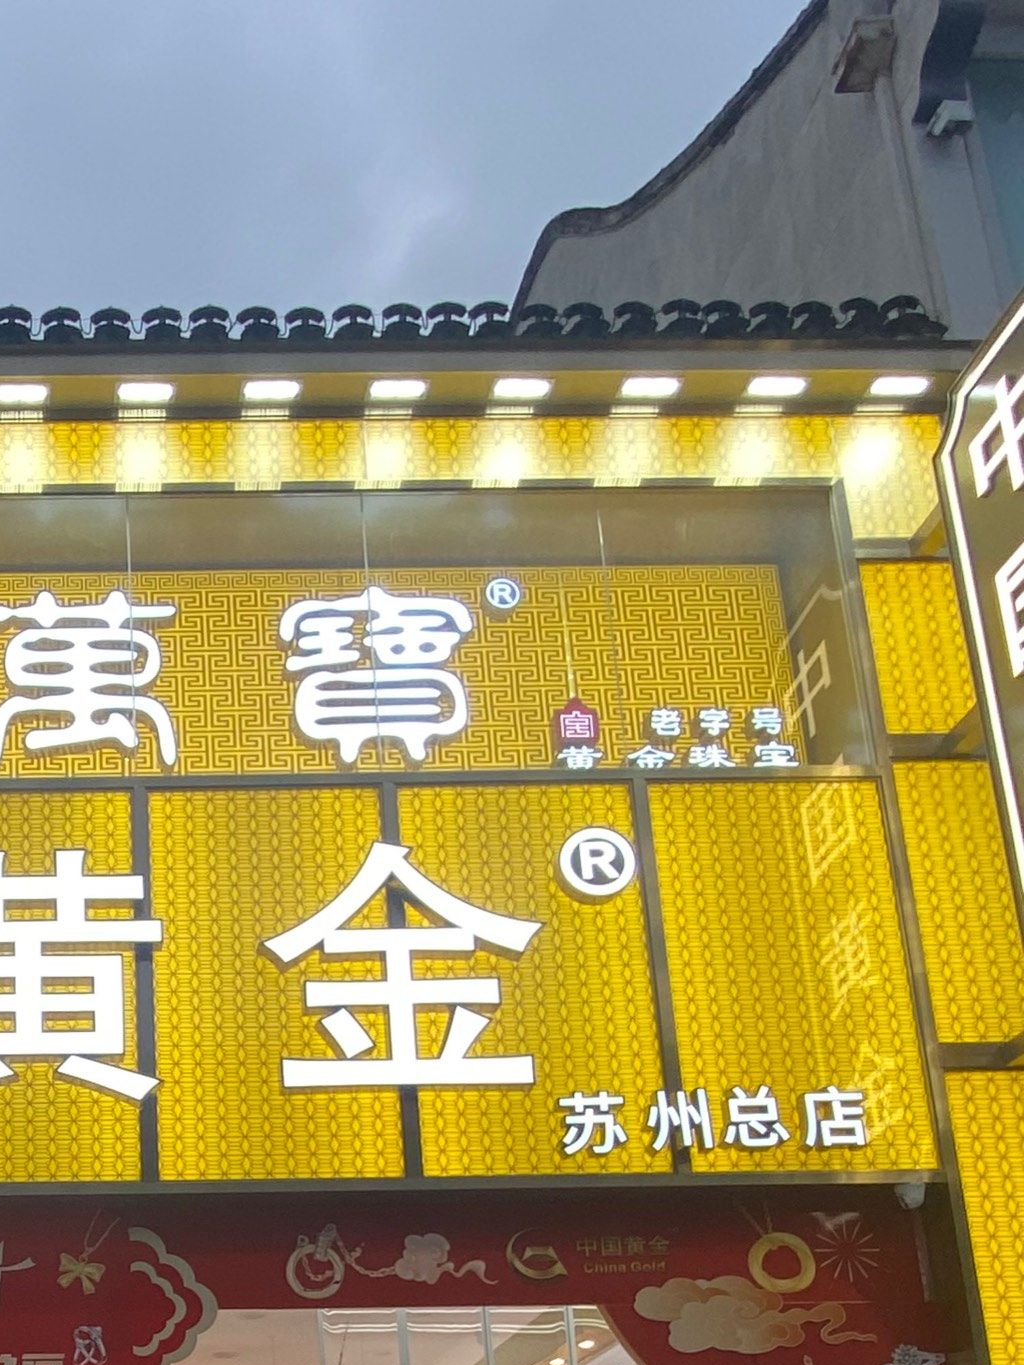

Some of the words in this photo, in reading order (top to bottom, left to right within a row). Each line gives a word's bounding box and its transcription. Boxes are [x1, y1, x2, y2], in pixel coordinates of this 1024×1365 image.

[650, 708, 783, 736] 老字号
[556, 741, 800, 769] 黄金珠宝
[559, 1086, 868, 1155] 苏州总店
[576, 1235, 670, 1257] 中国黄金
[584, 1261, 626, 1274] China
[630, 1261, 666, 1273] Gold
